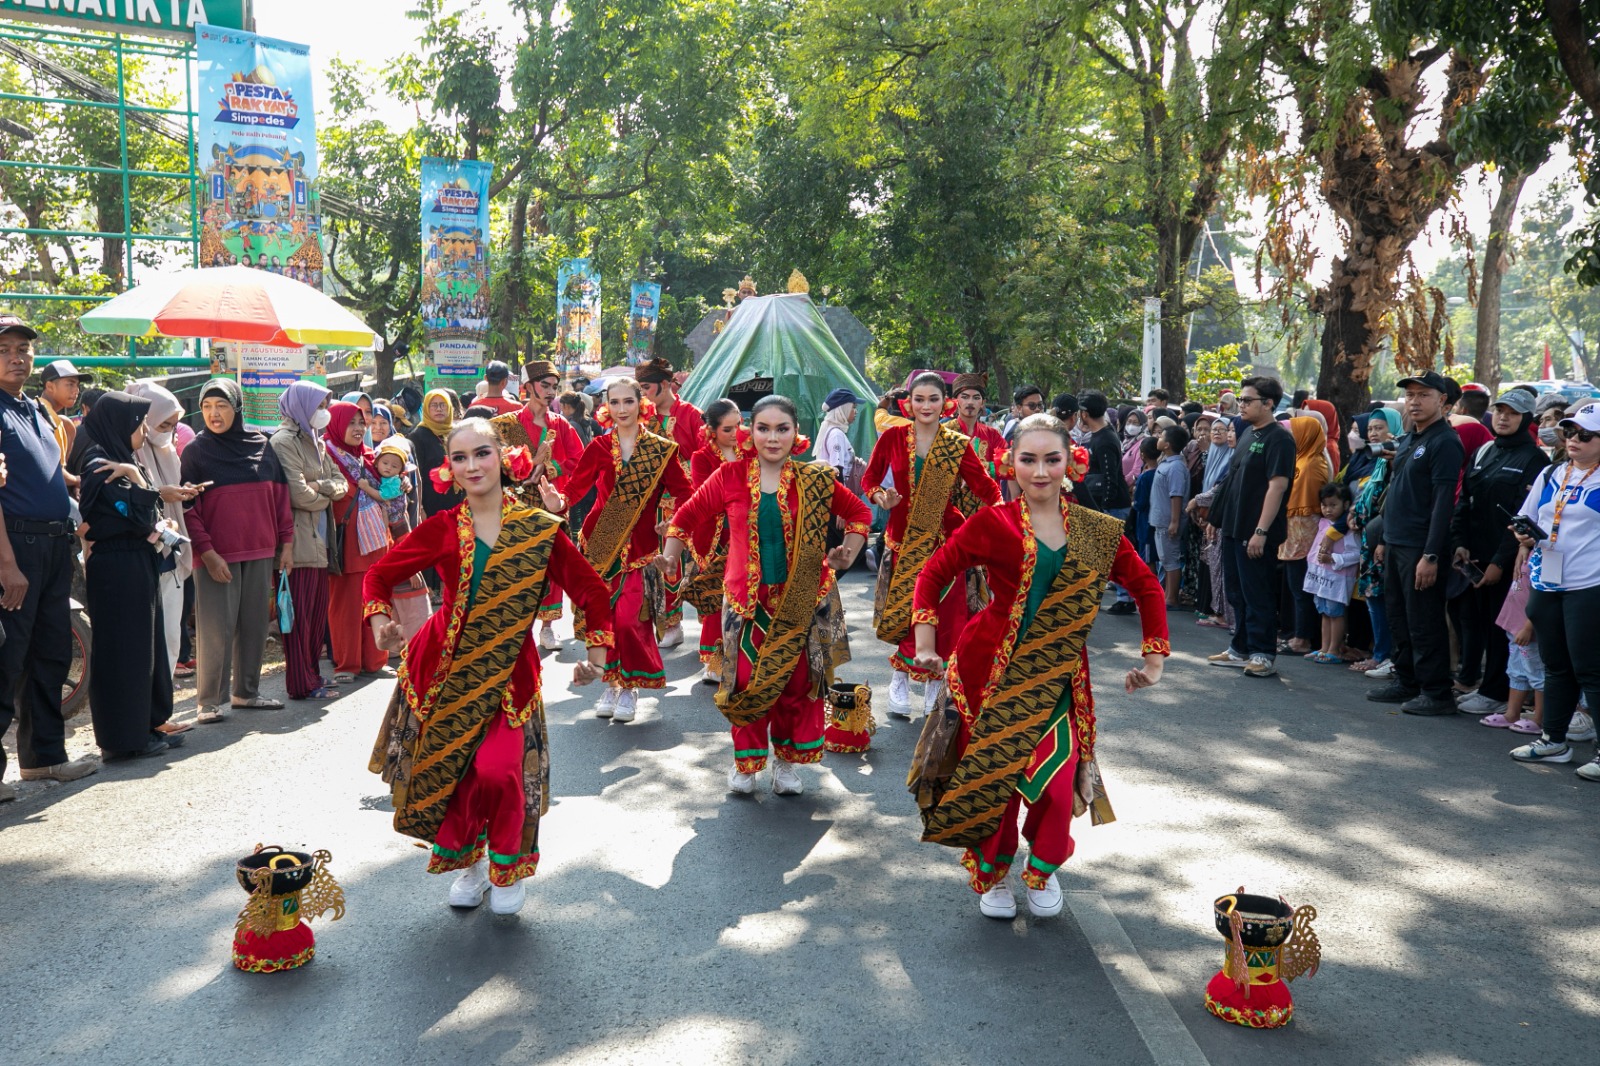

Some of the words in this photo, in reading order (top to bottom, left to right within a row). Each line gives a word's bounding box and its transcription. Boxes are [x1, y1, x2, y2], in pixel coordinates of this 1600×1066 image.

[234, 83, 284, 100] PESTA
[230, 96, 288, 115] RAKYAT
[231, 112, 285, 126] Simpedes
[444, 189, 474, 198] PESTA
[441, 196, 477, 206] RAKYAT
[441, 206, 474, 214] Simpedes
